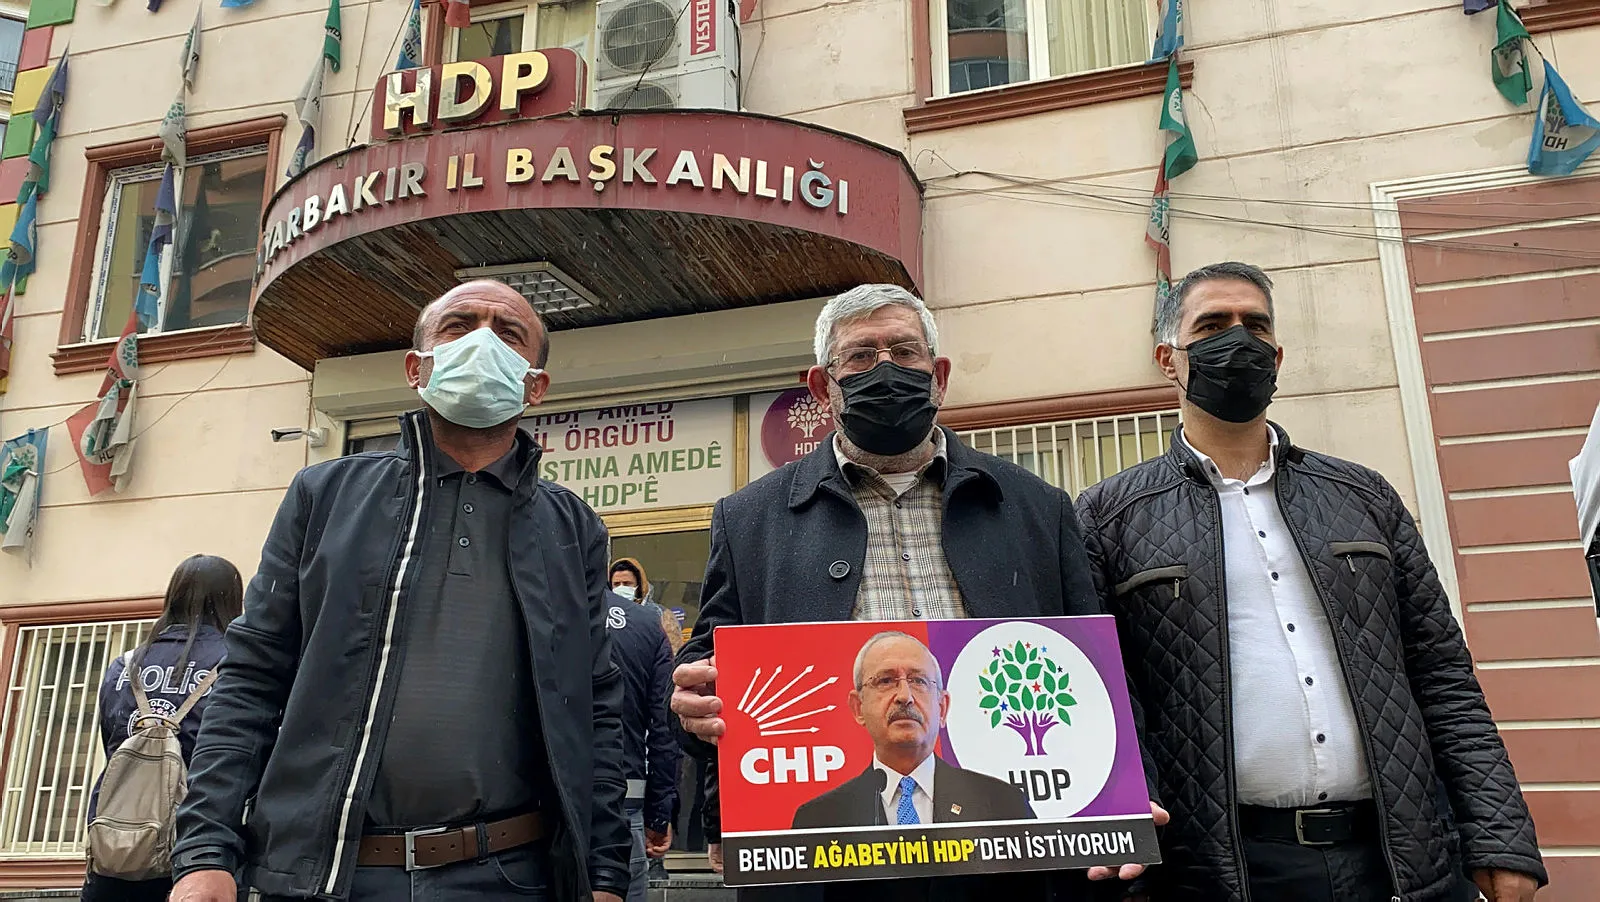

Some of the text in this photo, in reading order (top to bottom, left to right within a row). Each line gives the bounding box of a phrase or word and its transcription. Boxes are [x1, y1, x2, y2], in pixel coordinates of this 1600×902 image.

[384, 51, 549, 131] HDP
[253, 162, 428, 287] YARBAKIR
[504, 144, 849, 215] BAŞKANLIĞI
[565, 415, 674, 451] ÖRGÜTÜ
[628, 441, 722, 476] AMEDÊ
[583, 476, 659, 508] HDP'Ê
[740, 745, 845, 784] CHP
[738, 846, 808, 872] BENDE
[813, 835, 929, 869] AĞABEYİMİ
[1025, 829, 1136, 858] İSTİYORUM
